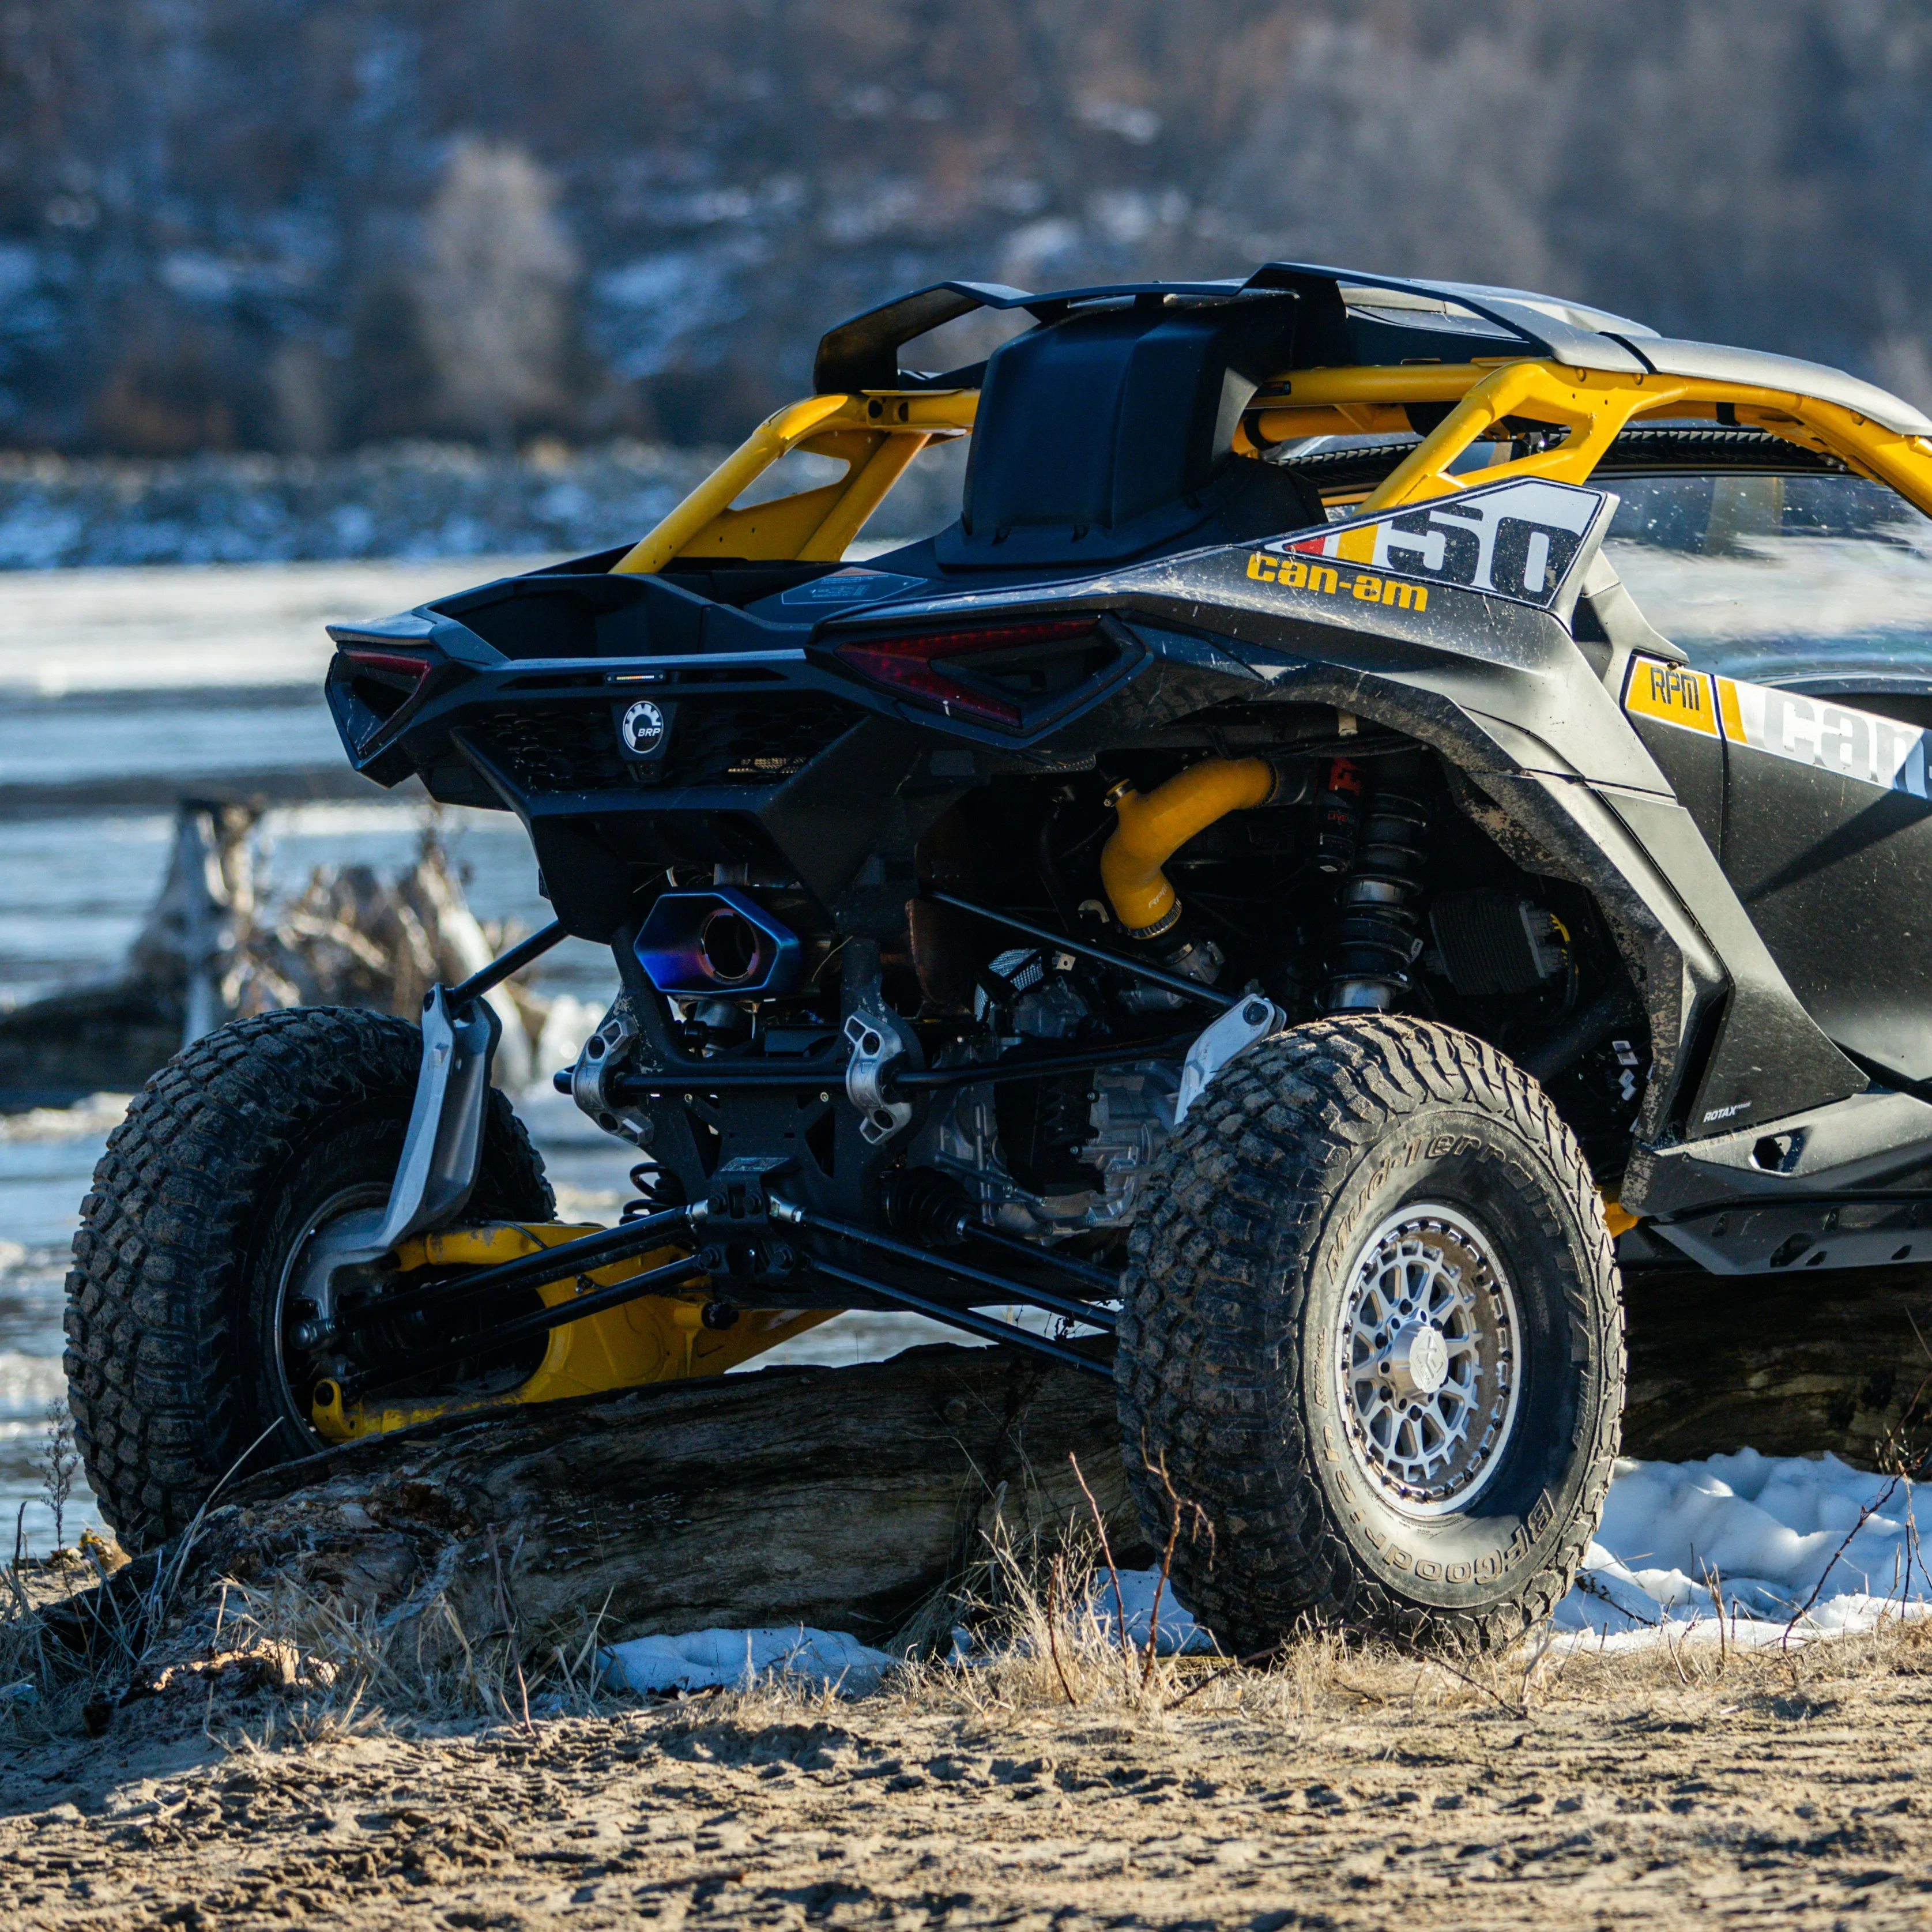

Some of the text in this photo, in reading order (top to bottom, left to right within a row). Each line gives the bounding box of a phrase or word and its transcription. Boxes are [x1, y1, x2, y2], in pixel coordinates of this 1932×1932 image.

[1246, 553, 1428, 612] can-am
[1650, 666, 1700, 711] RPM
[638, 728, 661, 737] BRP
[1763, 691, 1932, 800] can
[1703, 1105, 1737, 1123] ROTAX
[1323, 1425, 1556, 1586] BFGoodrich
